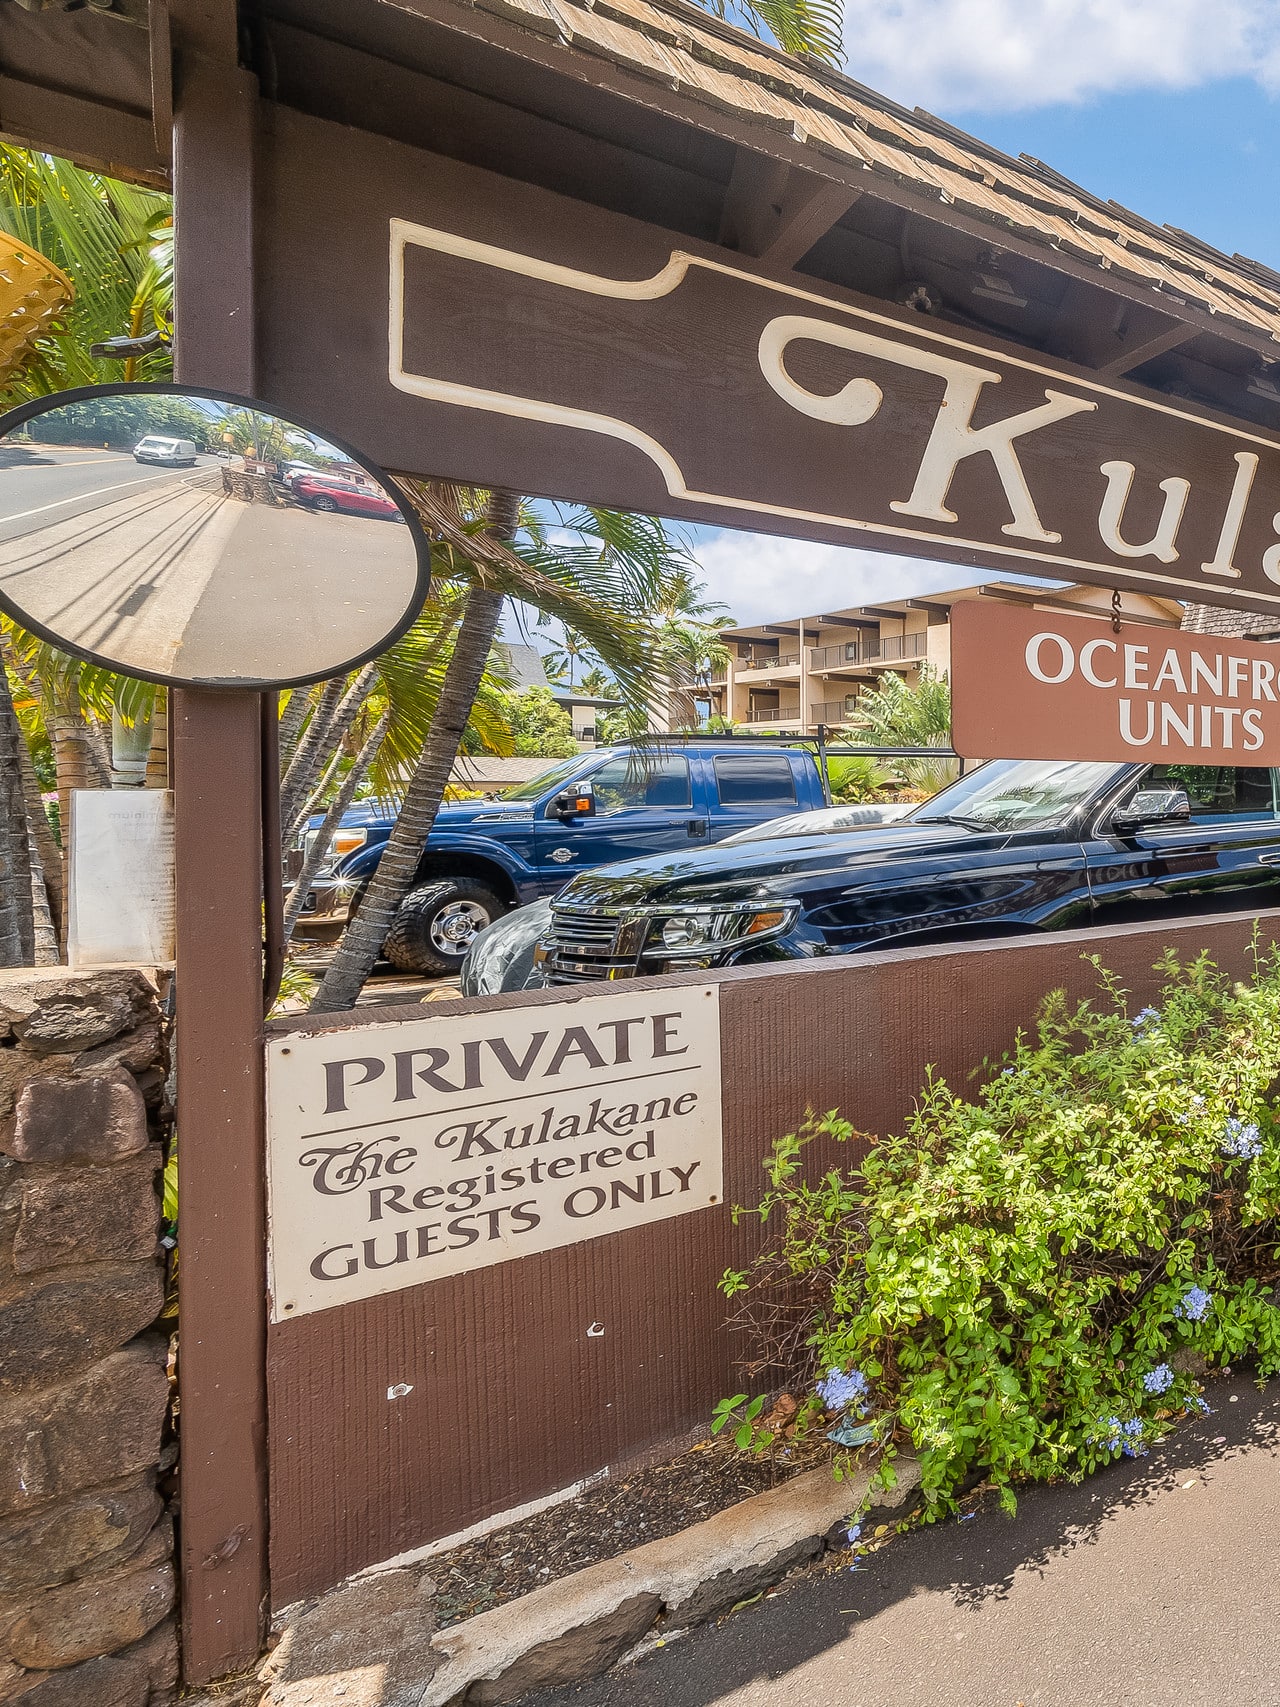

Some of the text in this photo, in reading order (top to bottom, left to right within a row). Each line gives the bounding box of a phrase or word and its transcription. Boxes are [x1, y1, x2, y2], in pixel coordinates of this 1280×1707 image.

[1118, 698, 1265, 752] UNITS
[322, 1012, 689, 1114] PRIVATE
[298, 1091, 699, 1196] The Kulakane
[368, 1131, 656, 1222] Registered
[309, 1161, 702, 1281] GUESTS ONLY
